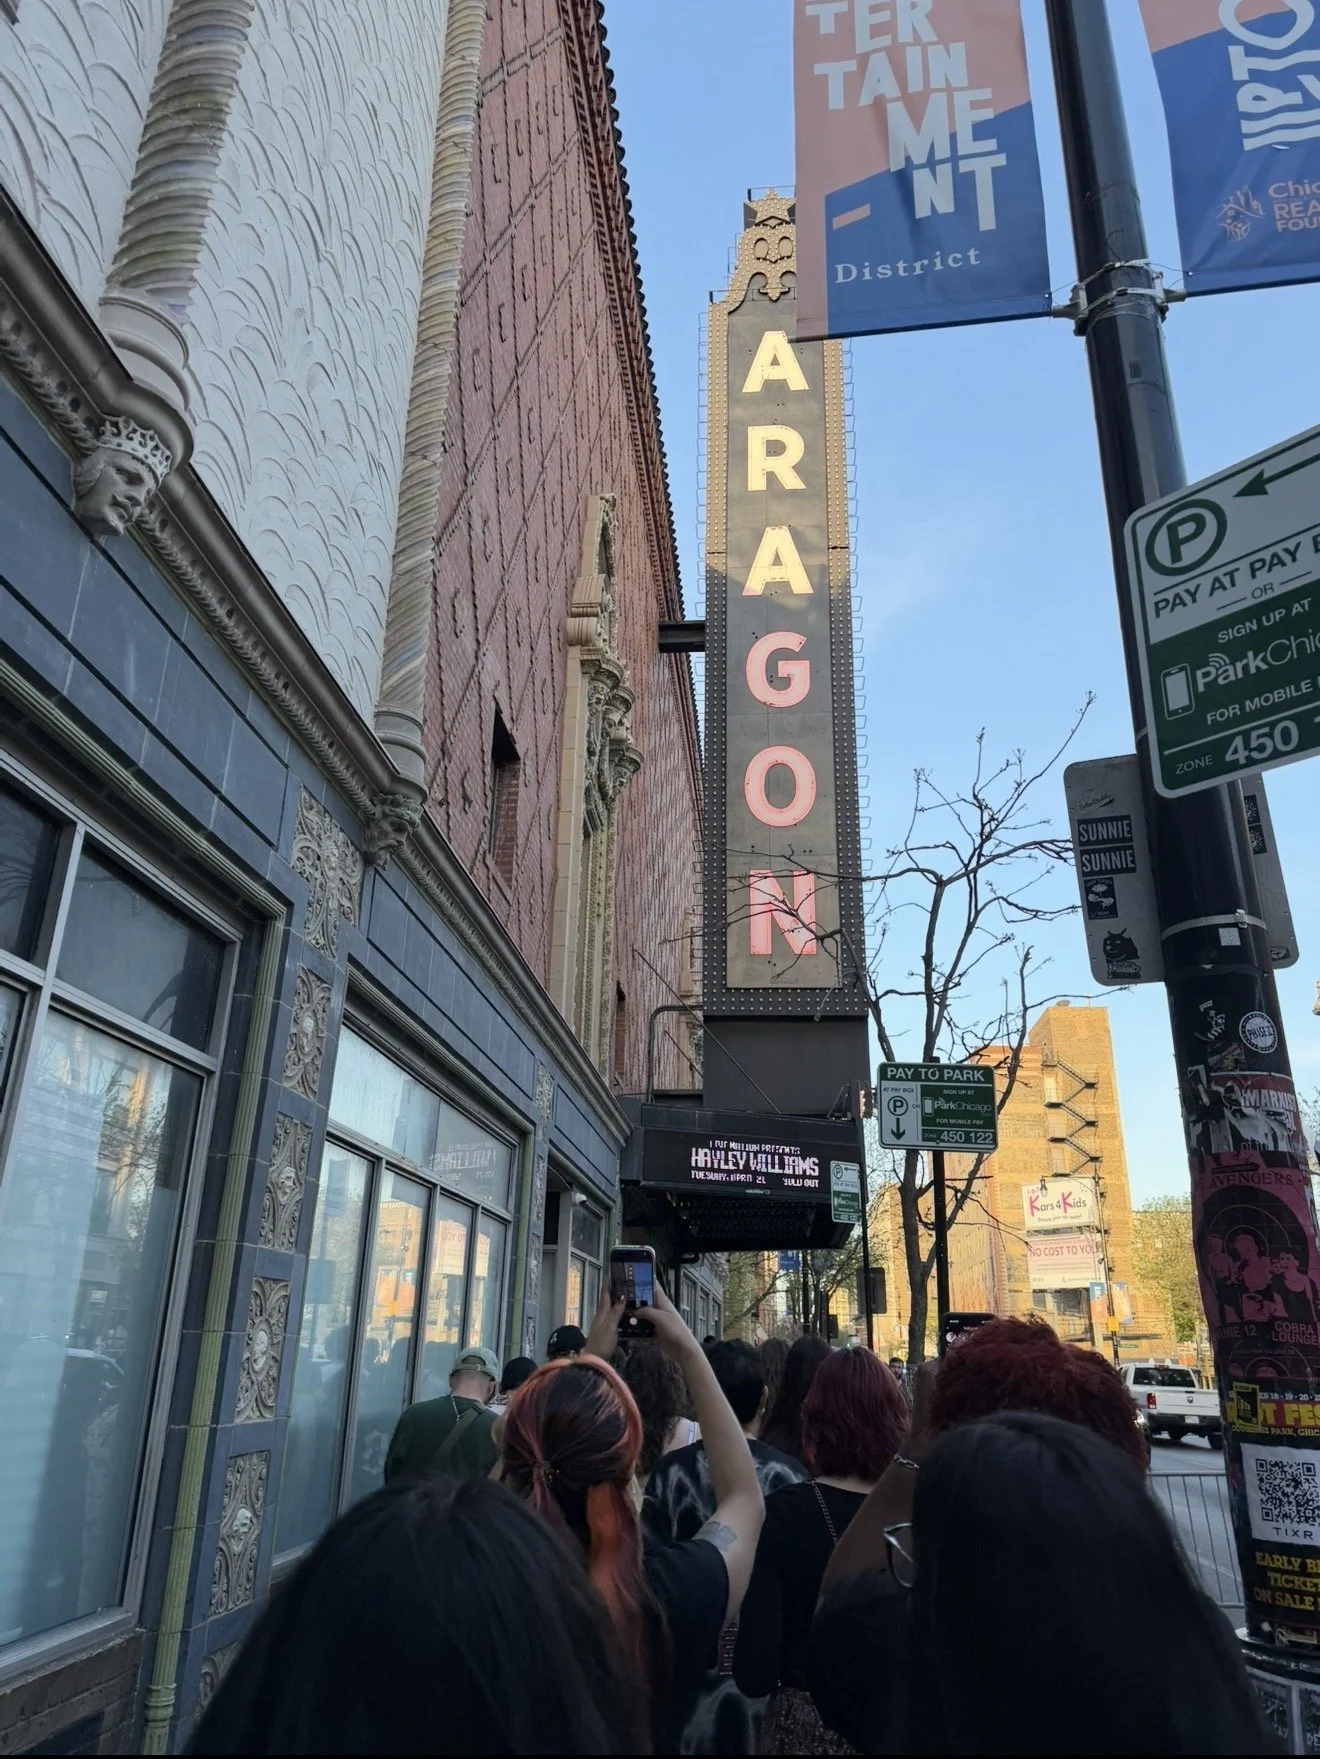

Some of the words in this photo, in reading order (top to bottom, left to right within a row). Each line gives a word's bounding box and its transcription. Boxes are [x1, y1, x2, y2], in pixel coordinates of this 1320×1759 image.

[806, 0, 938, 54] TER
[814, 42, 968, 109] TAIN
[887, 88, 997, 172] ME
[913, 153, 1007, 231] NT
[1276, 216, 1320, 232] FOU
[835, 246, 980, 283] District
[1167, 512, 1206, 565] P
[1154, 584, 1203, 619] PAY
[1208, 568, 1240, 597] AT
[1250, 541, 1302, 580] PAY
[1252, 583, 1275, 600] OR
[1218, 618, 1258, 643] SIGN
[1262, 608, 1287, 628] UP
[1291, 597, 1312, 616] AT
[742, 330, 816, 955] ARAGON
[1206, 704, 1241, 725] FOR
[1245, 679, 1312, 713] MOBILE
[1175, 754, 1214, 775] ZONE
[1224, 719, 1300, 766] 450
[1078, 819, 1132, 842] SUNNIE
[1082, 850, 1135, 874] SUNNIE
[887, 1067, 914, 1079] PAY
[918, 1068, 939, 1080] TO
[944, 1069, 985, 1081] PARK
[934, 1098, 992, 1113] ParkChicago
[940, 1131, 965, 1142] 450
[969, 1132, 994, 1144] 122
[691, 1147, 747, 1170] HAYLEY
[749, 1152, 819, 1176] WILLIAMS
[1209, 1169, 1293, 1188] AVENGERS
[1044, 1246, 1064, 1256] COST
[1066, 1245, 1078, 1255] TO
[1243, 1325, 1257, 1336] 12
[1272, 1331, 1317, 1345] LOUNGE
[1275, 1321, 1313, 1335] COBRA
[1273, 1527, 1314, 1540] TIXR
[1255, 1551, 1302, 1572] EARLY
[1254, 1587, 1272, 1603] ON
[1275, 1591, 1315, 1610] SALE
